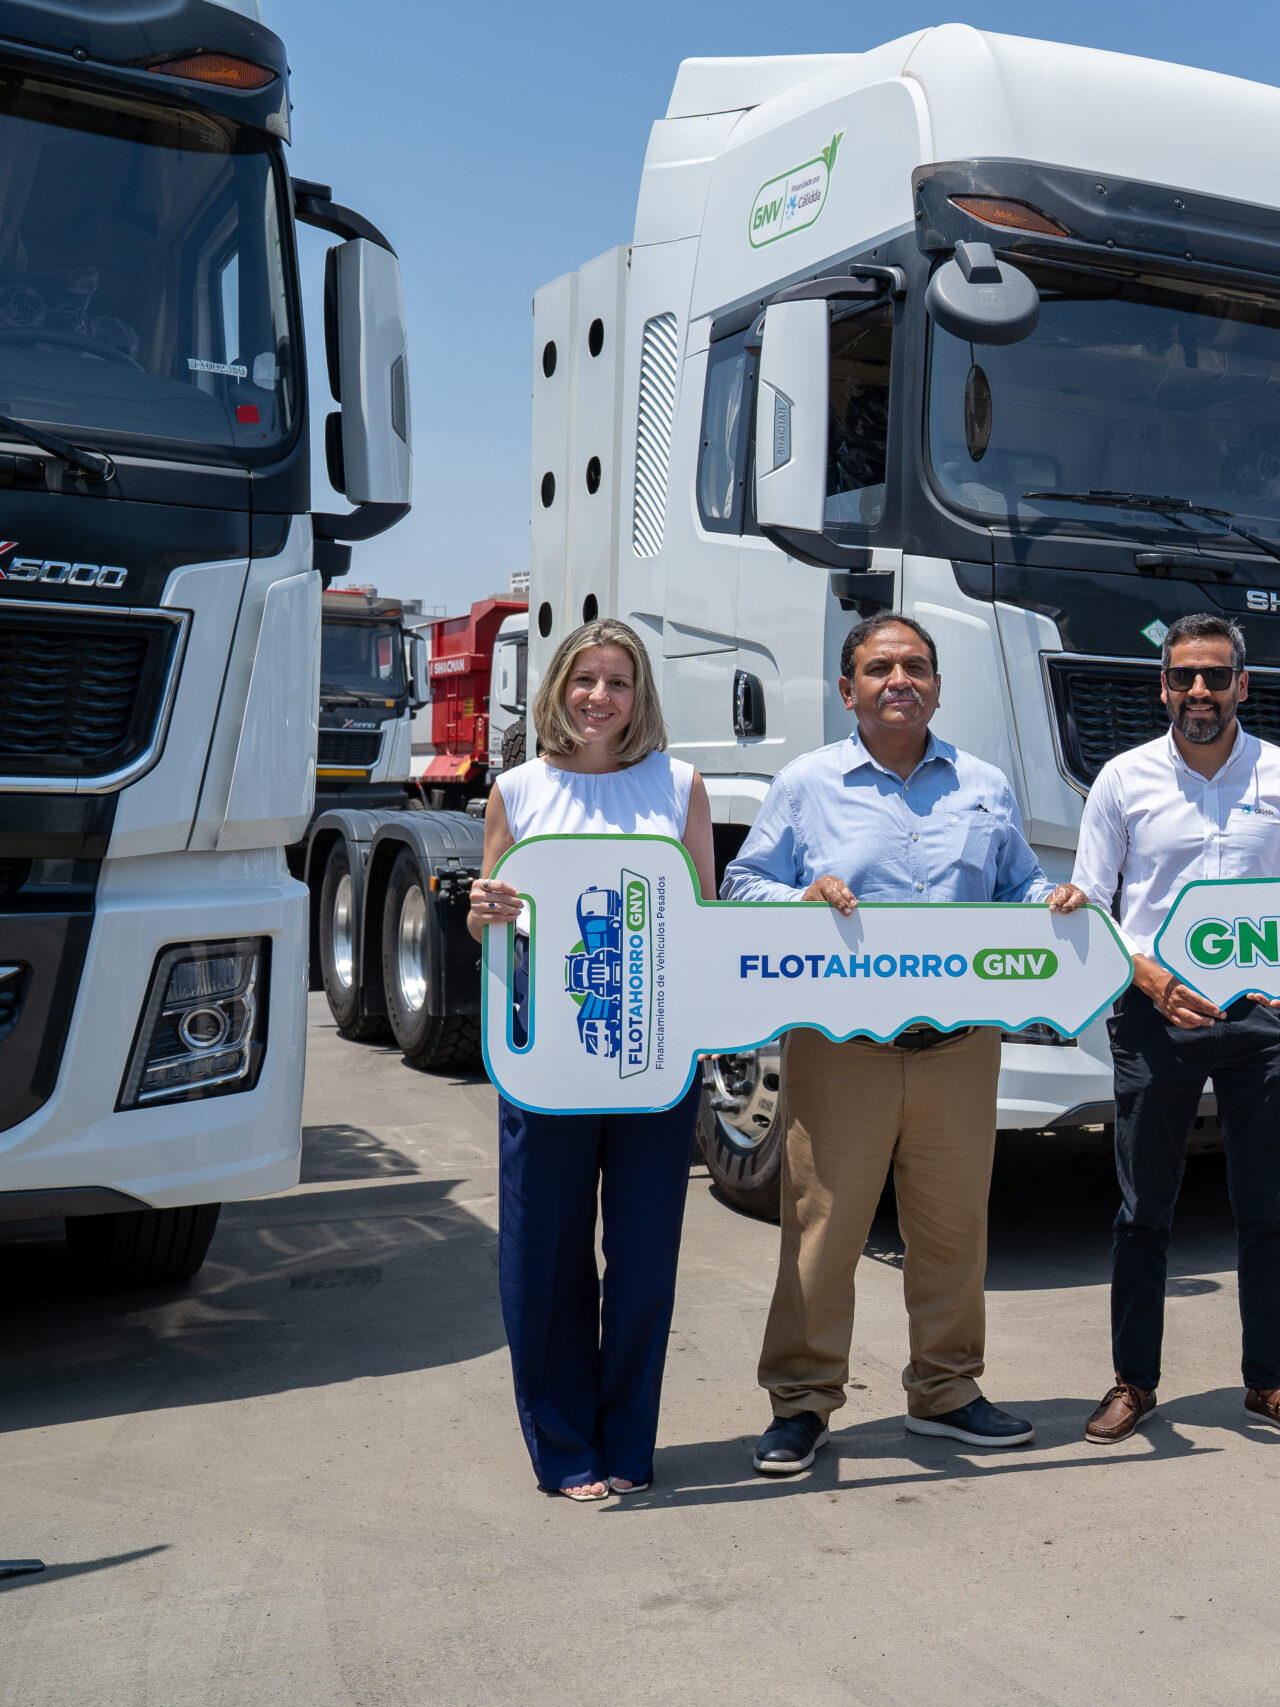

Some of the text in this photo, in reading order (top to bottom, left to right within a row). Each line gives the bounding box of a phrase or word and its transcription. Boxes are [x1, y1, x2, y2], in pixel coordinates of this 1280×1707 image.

[813, 175, 822, 184] por
[797, 188, 822, 209] Cálidda
[753, 197, 784, 230] GNV
[777, 407, 786, 457] SHACMAN
[435, 659, 465, 675] SHACMAN
[628, 887, 644, 1065] FLOTAHORRO GNV
[655, 876, 666, 1070] Financiamiento de Vehículos Pesados
[739, 953, 1048, 979] FLOTAHORRO GNV
